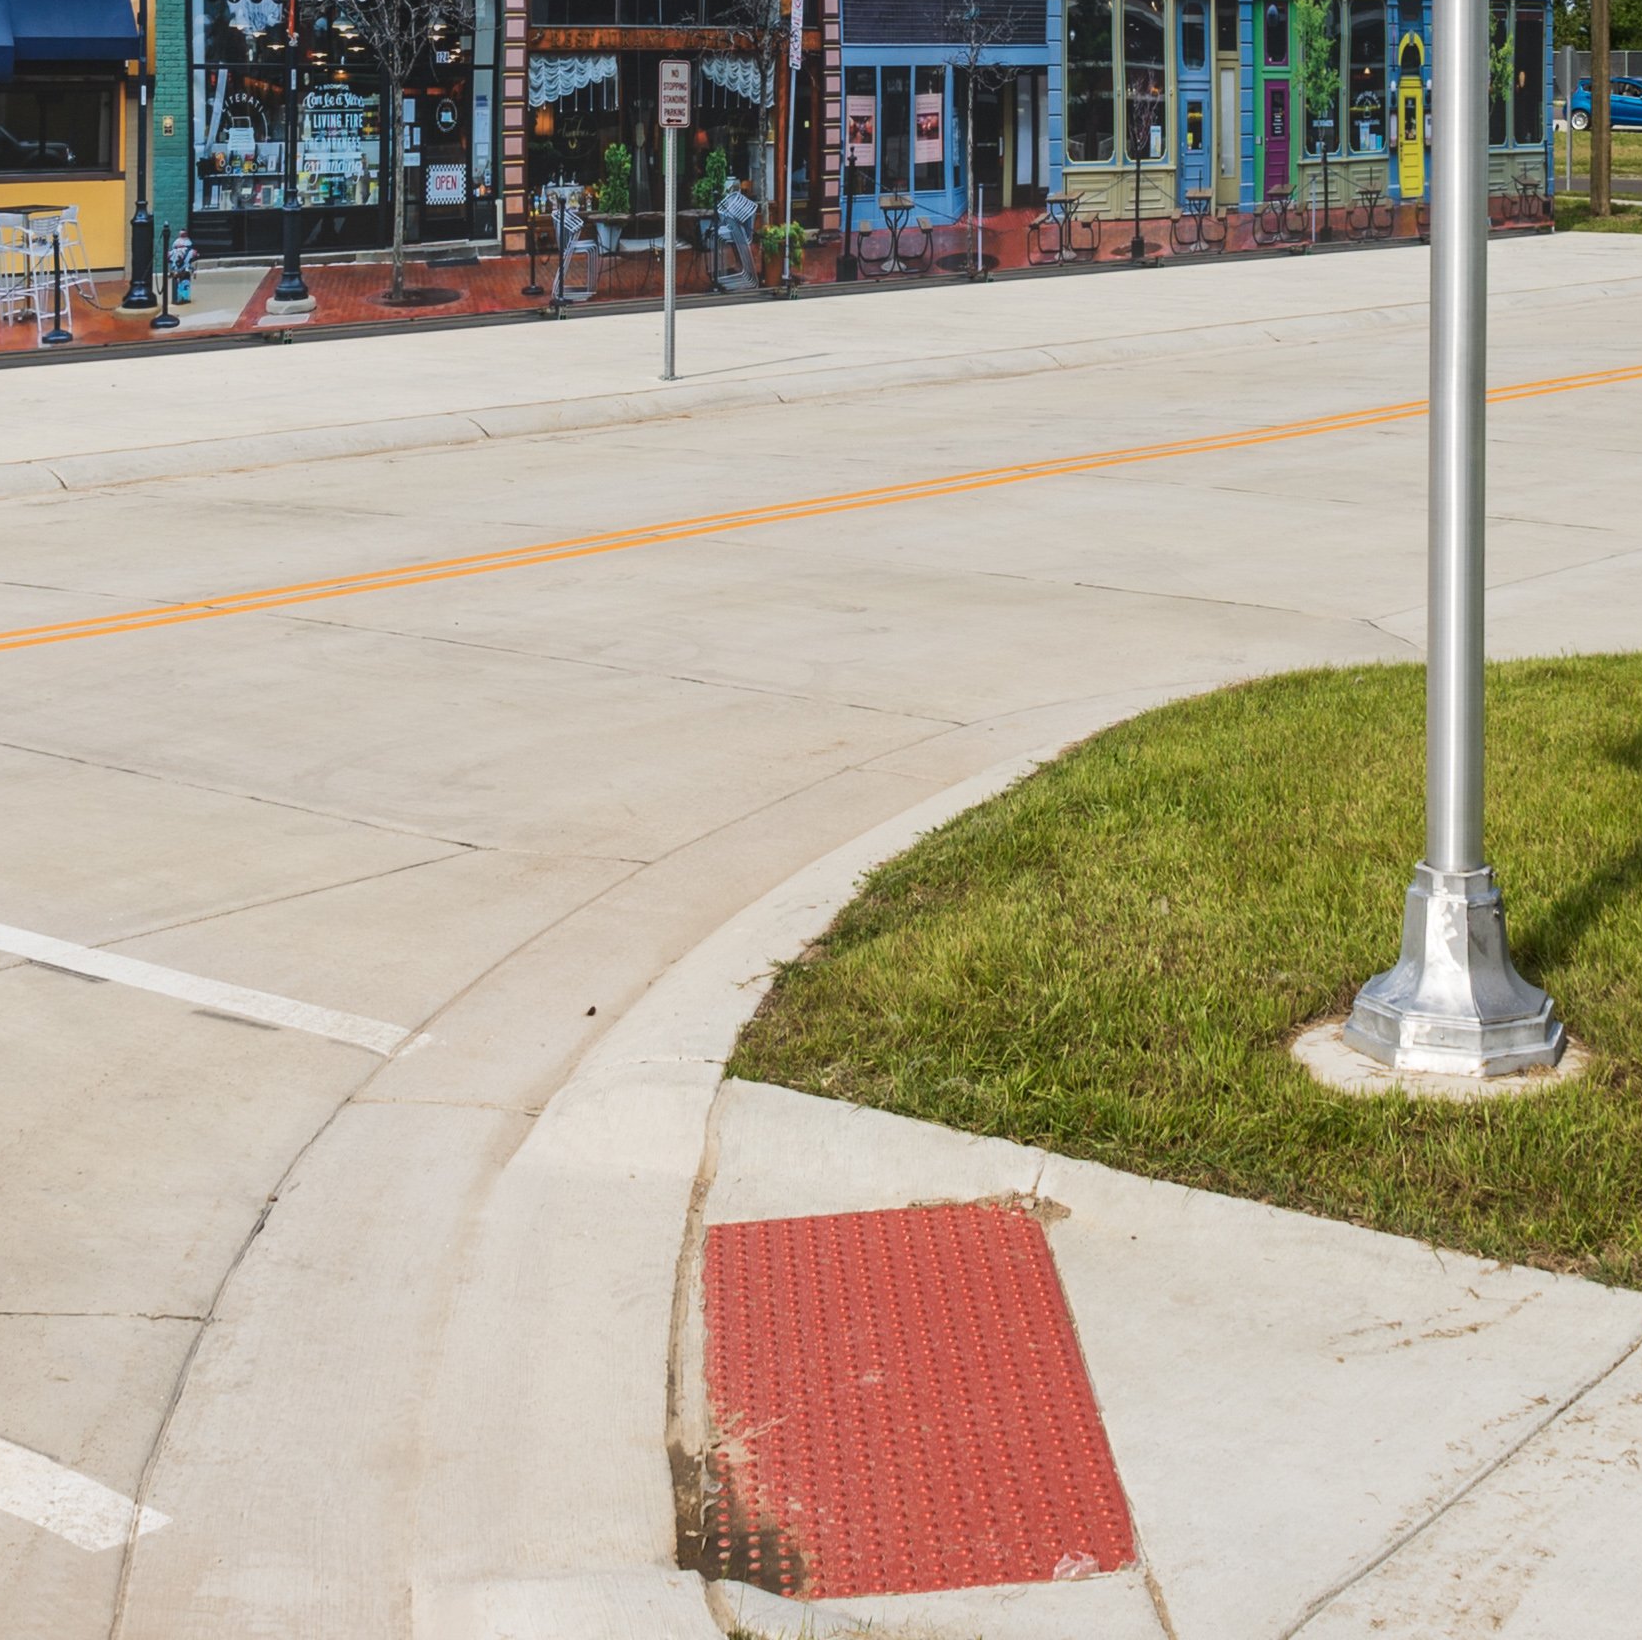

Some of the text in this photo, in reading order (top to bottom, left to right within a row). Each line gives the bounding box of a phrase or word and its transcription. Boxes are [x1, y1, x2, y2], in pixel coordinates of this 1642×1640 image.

[671, 69, 679, 78] NO
[663, 82, 687, 91] STOPPING
[663, 95, 687, 104] STANDING
[663, 108, 686, 117] PARKING
[313, 113, 342, 129] LIVING
[345, 113, 364, 129] FIRE
[435, 175, 457, 191] OPEN
